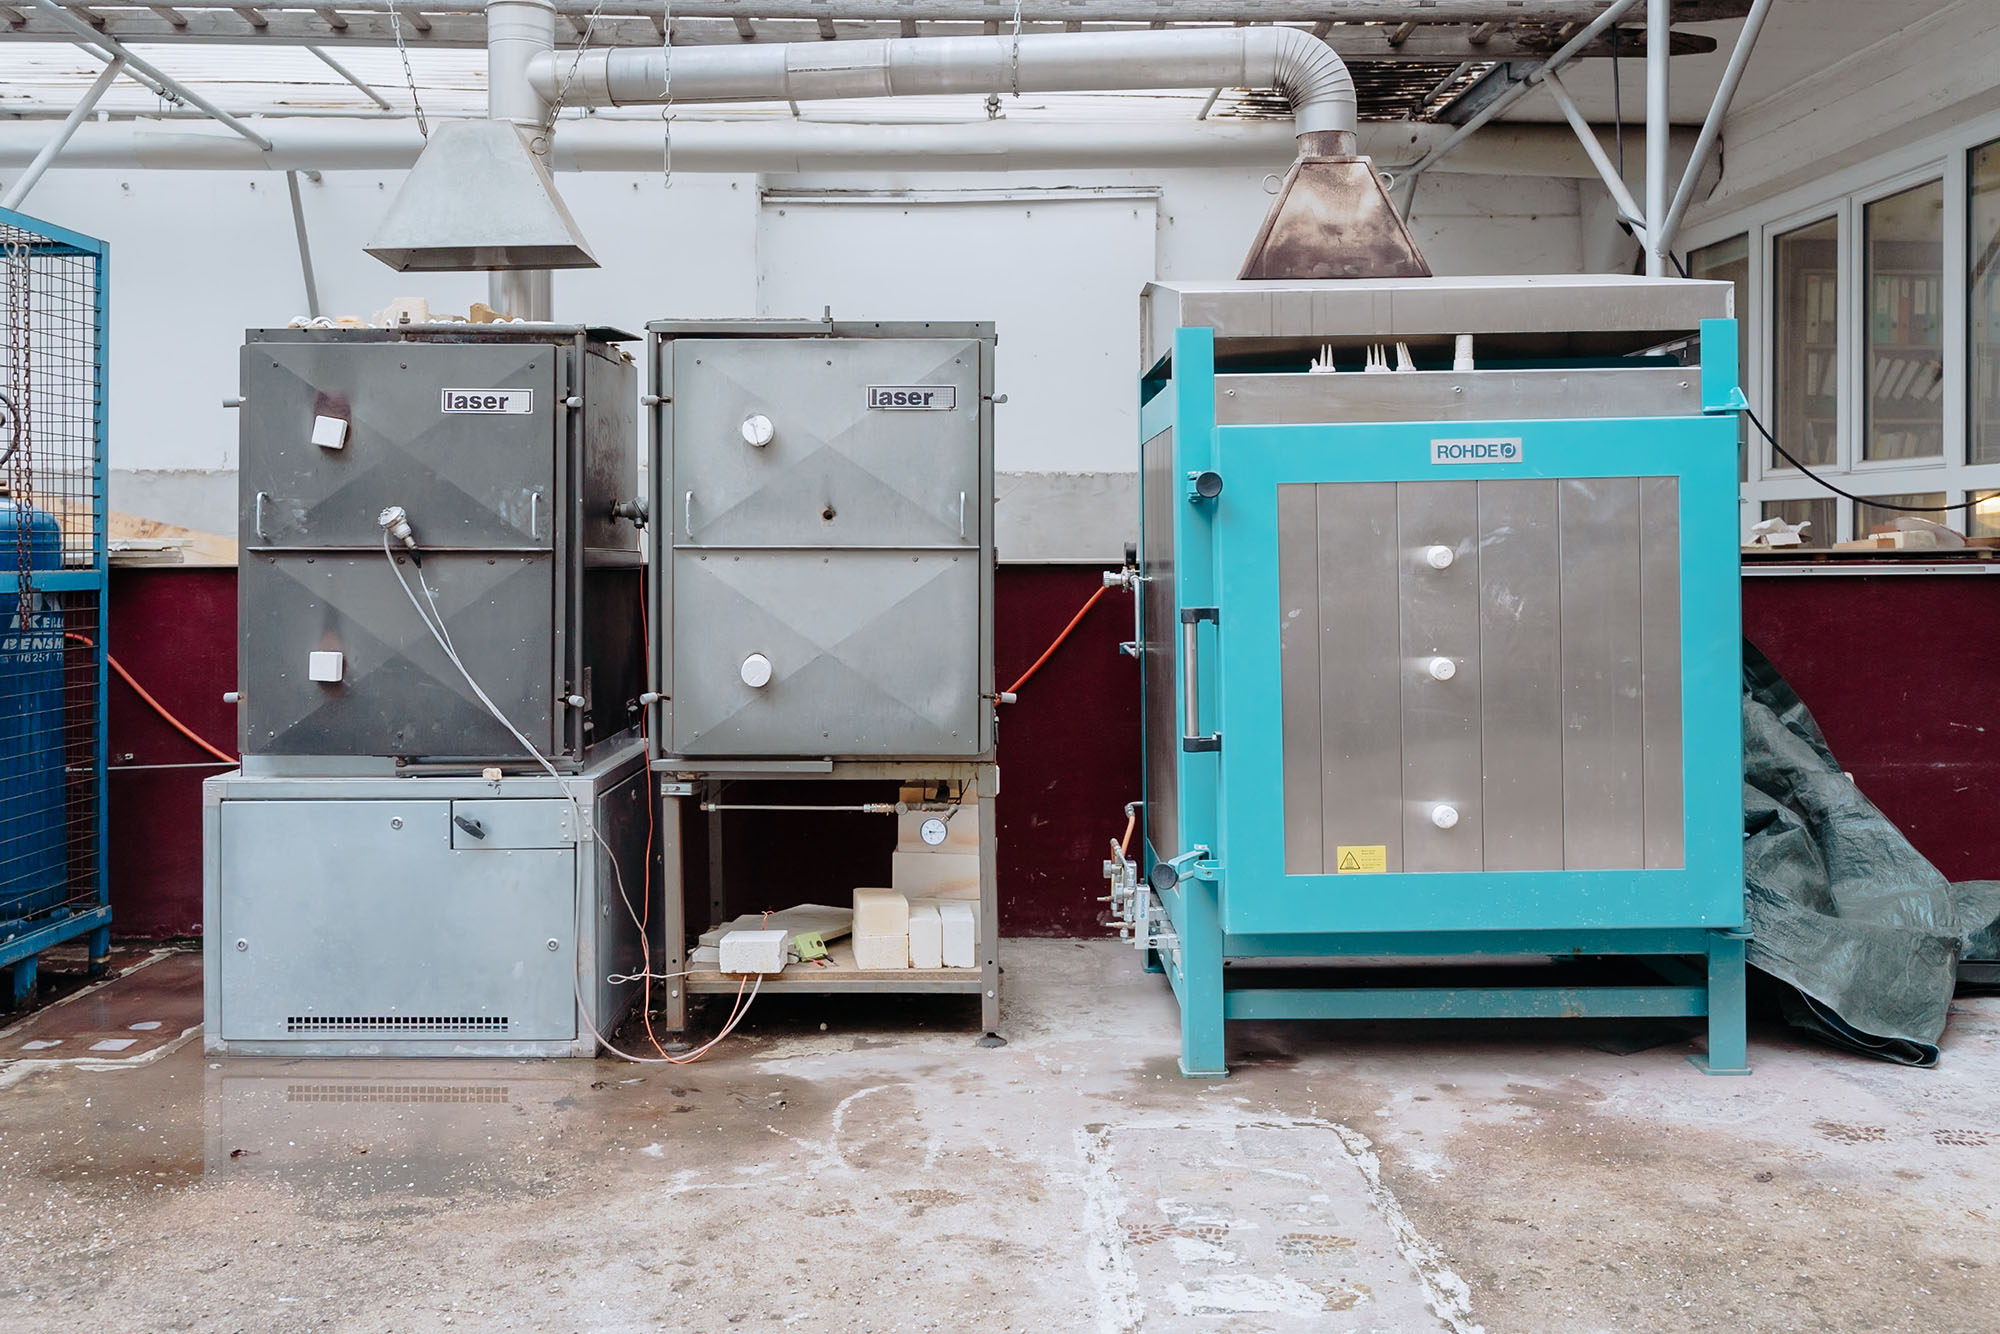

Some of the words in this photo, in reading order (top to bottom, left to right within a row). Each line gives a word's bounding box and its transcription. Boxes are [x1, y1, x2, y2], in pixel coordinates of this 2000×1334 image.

[447, 392, 509, 409] laser
[872, 389, 934, 405] laser
[1437, 444, 1499, 459] ROHDE
